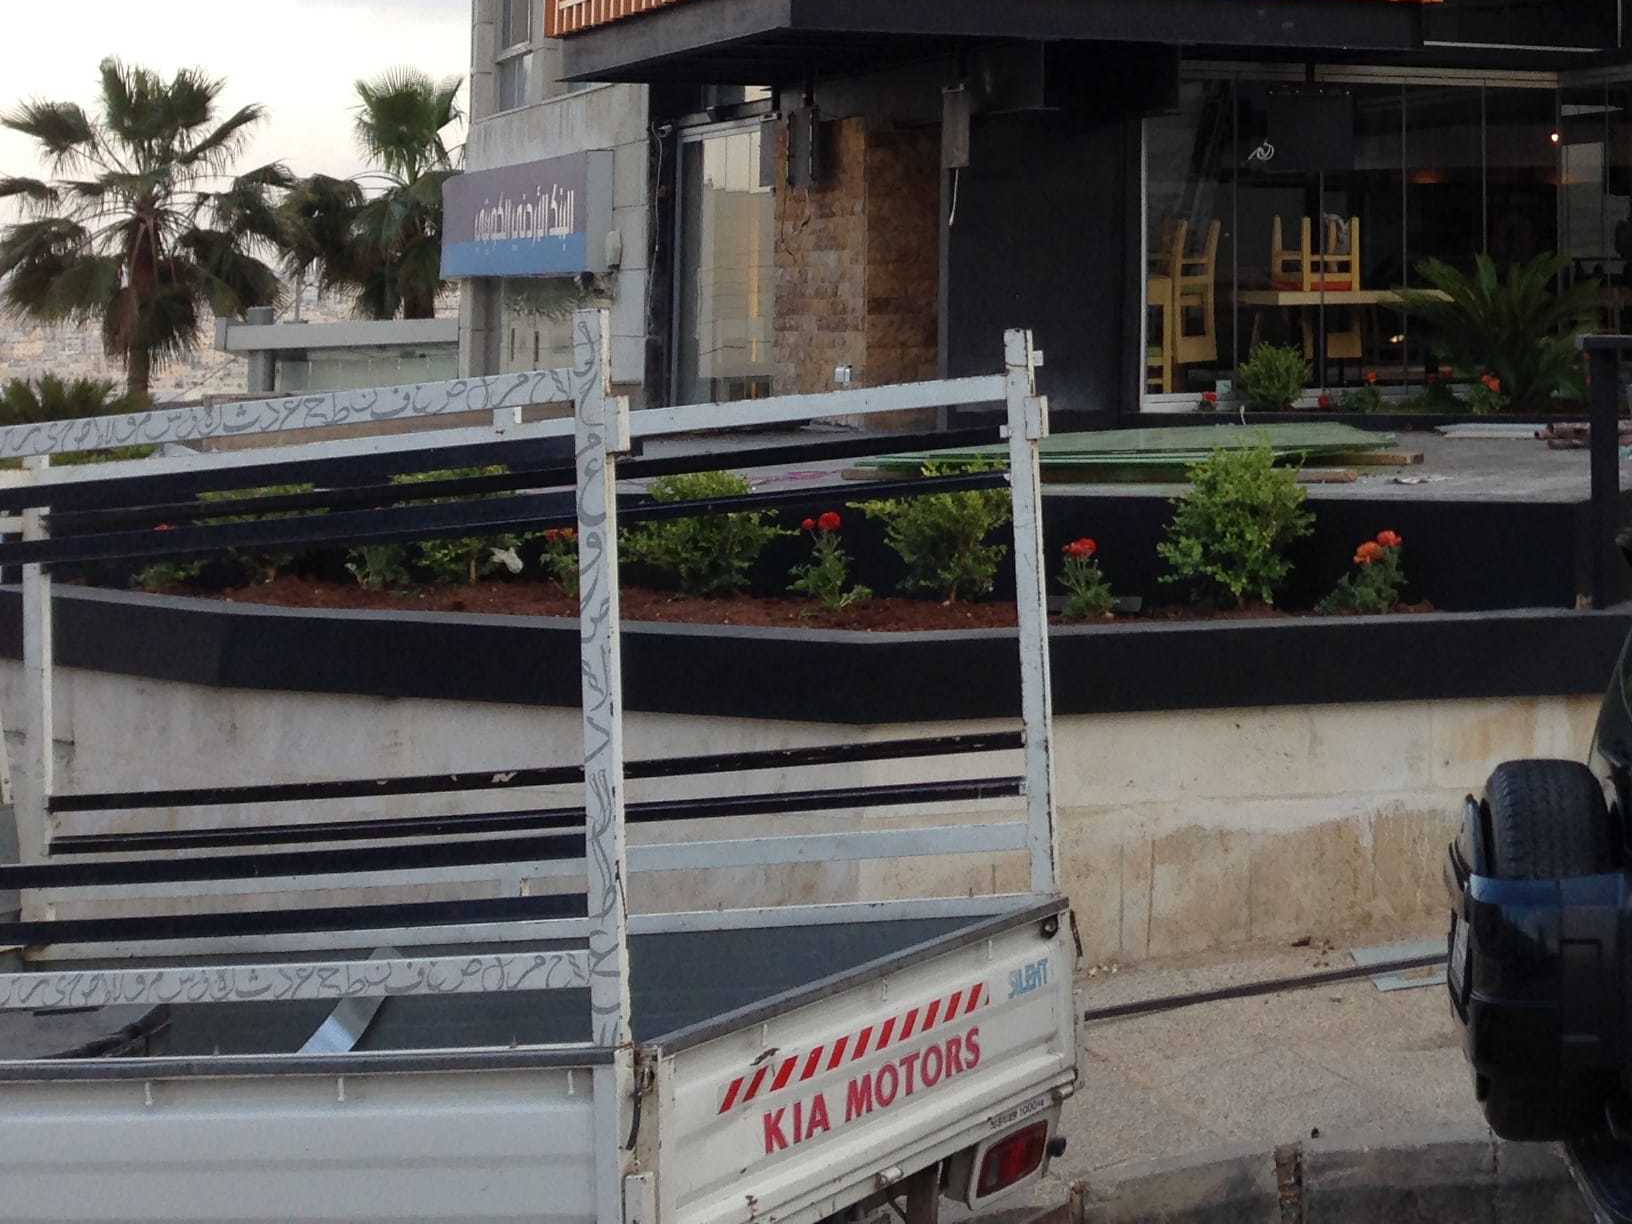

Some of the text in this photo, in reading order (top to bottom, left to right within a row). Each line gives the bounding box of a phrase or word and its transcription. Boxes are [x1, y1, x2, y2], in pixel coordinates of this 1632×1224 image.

[549, 184, 574, 251] البنك
[762, 1026, 982, 1155] KIA MOTORS
